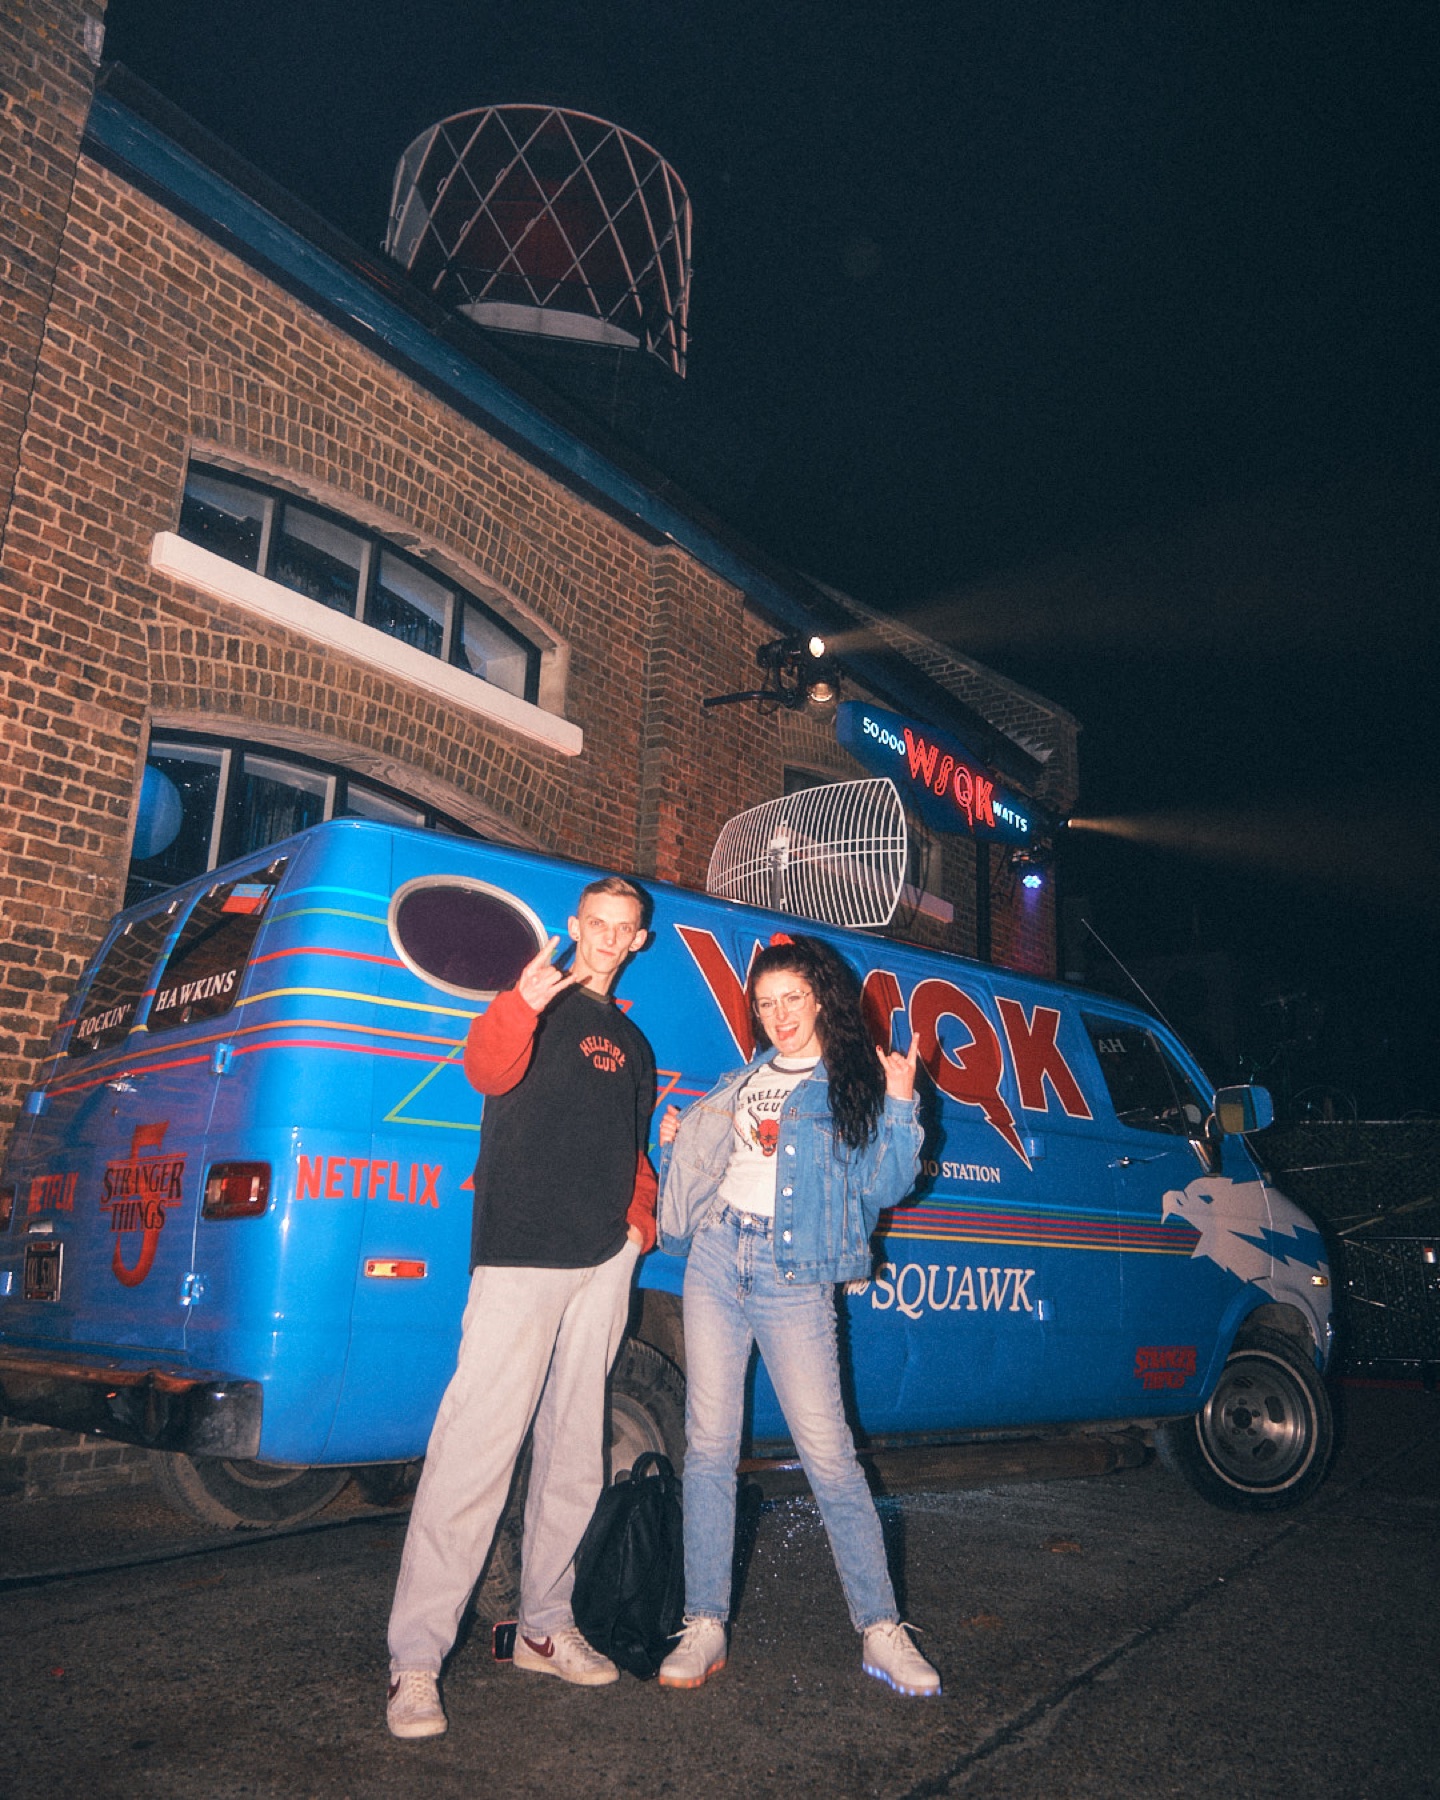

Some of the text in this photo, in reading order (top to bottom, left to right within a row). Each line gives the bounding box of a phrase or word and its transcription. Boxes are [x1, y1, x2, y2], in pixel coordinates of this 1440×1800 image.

[863, 717, 1028, 833] 50,000 WSQK WATTS
[155, 969, 237, 1012] HAWKINS
[579, 1035, 627, 1068] HELLFIRE
[592, 1054, 617, 1073] CLUB
[747, 1088, 792, 1104] HELLF
[756, 1102, 781, 1112] CLU
[101, 1160, 186, 1204] STRANGER
[296, 1155, 443, 1209] NETFLIX
[941, 1160, 1001, 1184] STATION
[110, 1200, 167, 1232] THINGS
[871, 1262, 1036, 1320] SQUAWK
